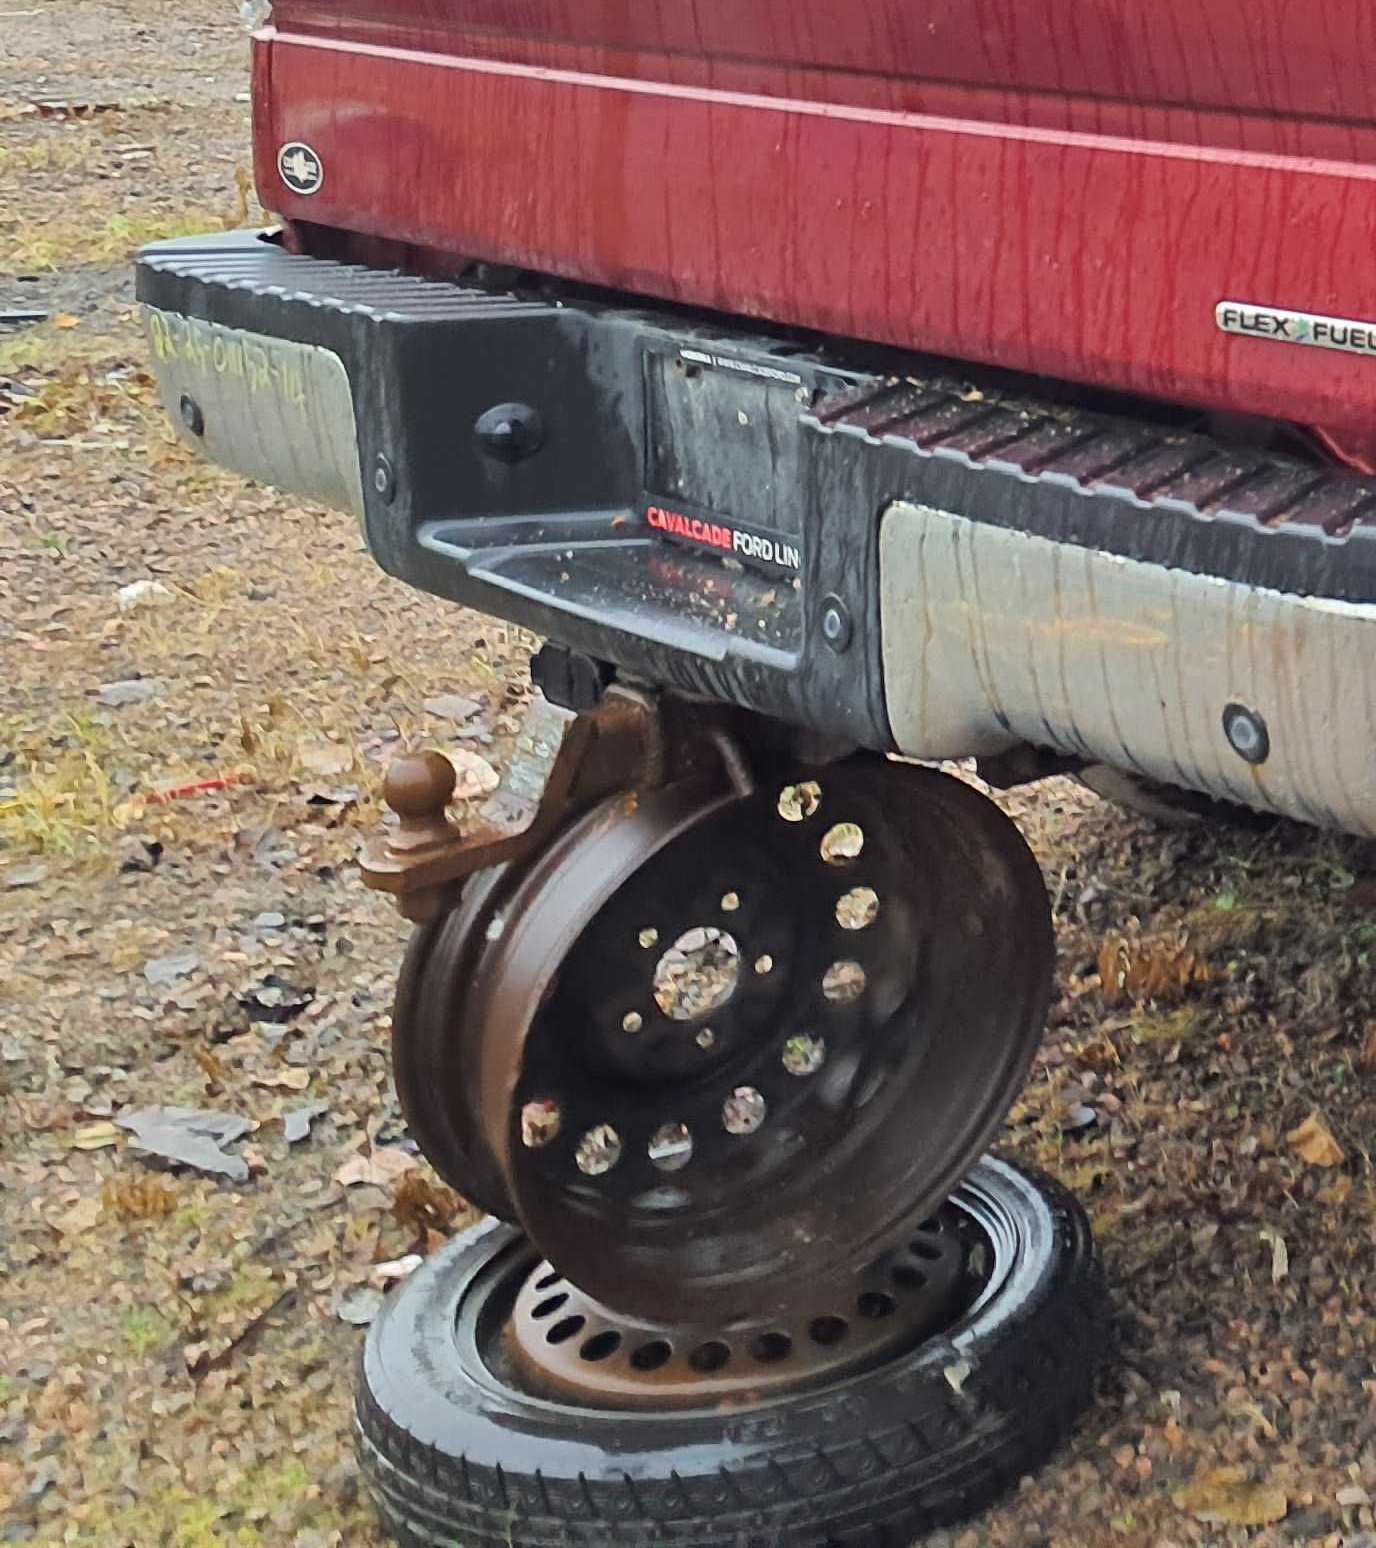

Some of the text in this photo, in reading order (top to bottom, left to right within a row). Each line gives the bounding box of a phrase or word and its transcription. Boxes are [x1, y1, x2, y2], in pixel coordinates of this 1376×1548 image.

[1222, 308, 1291, 337] FLEX
[647, 506, 732, 549] CAVALCADE
[732, 529, 774, 562] FORD
